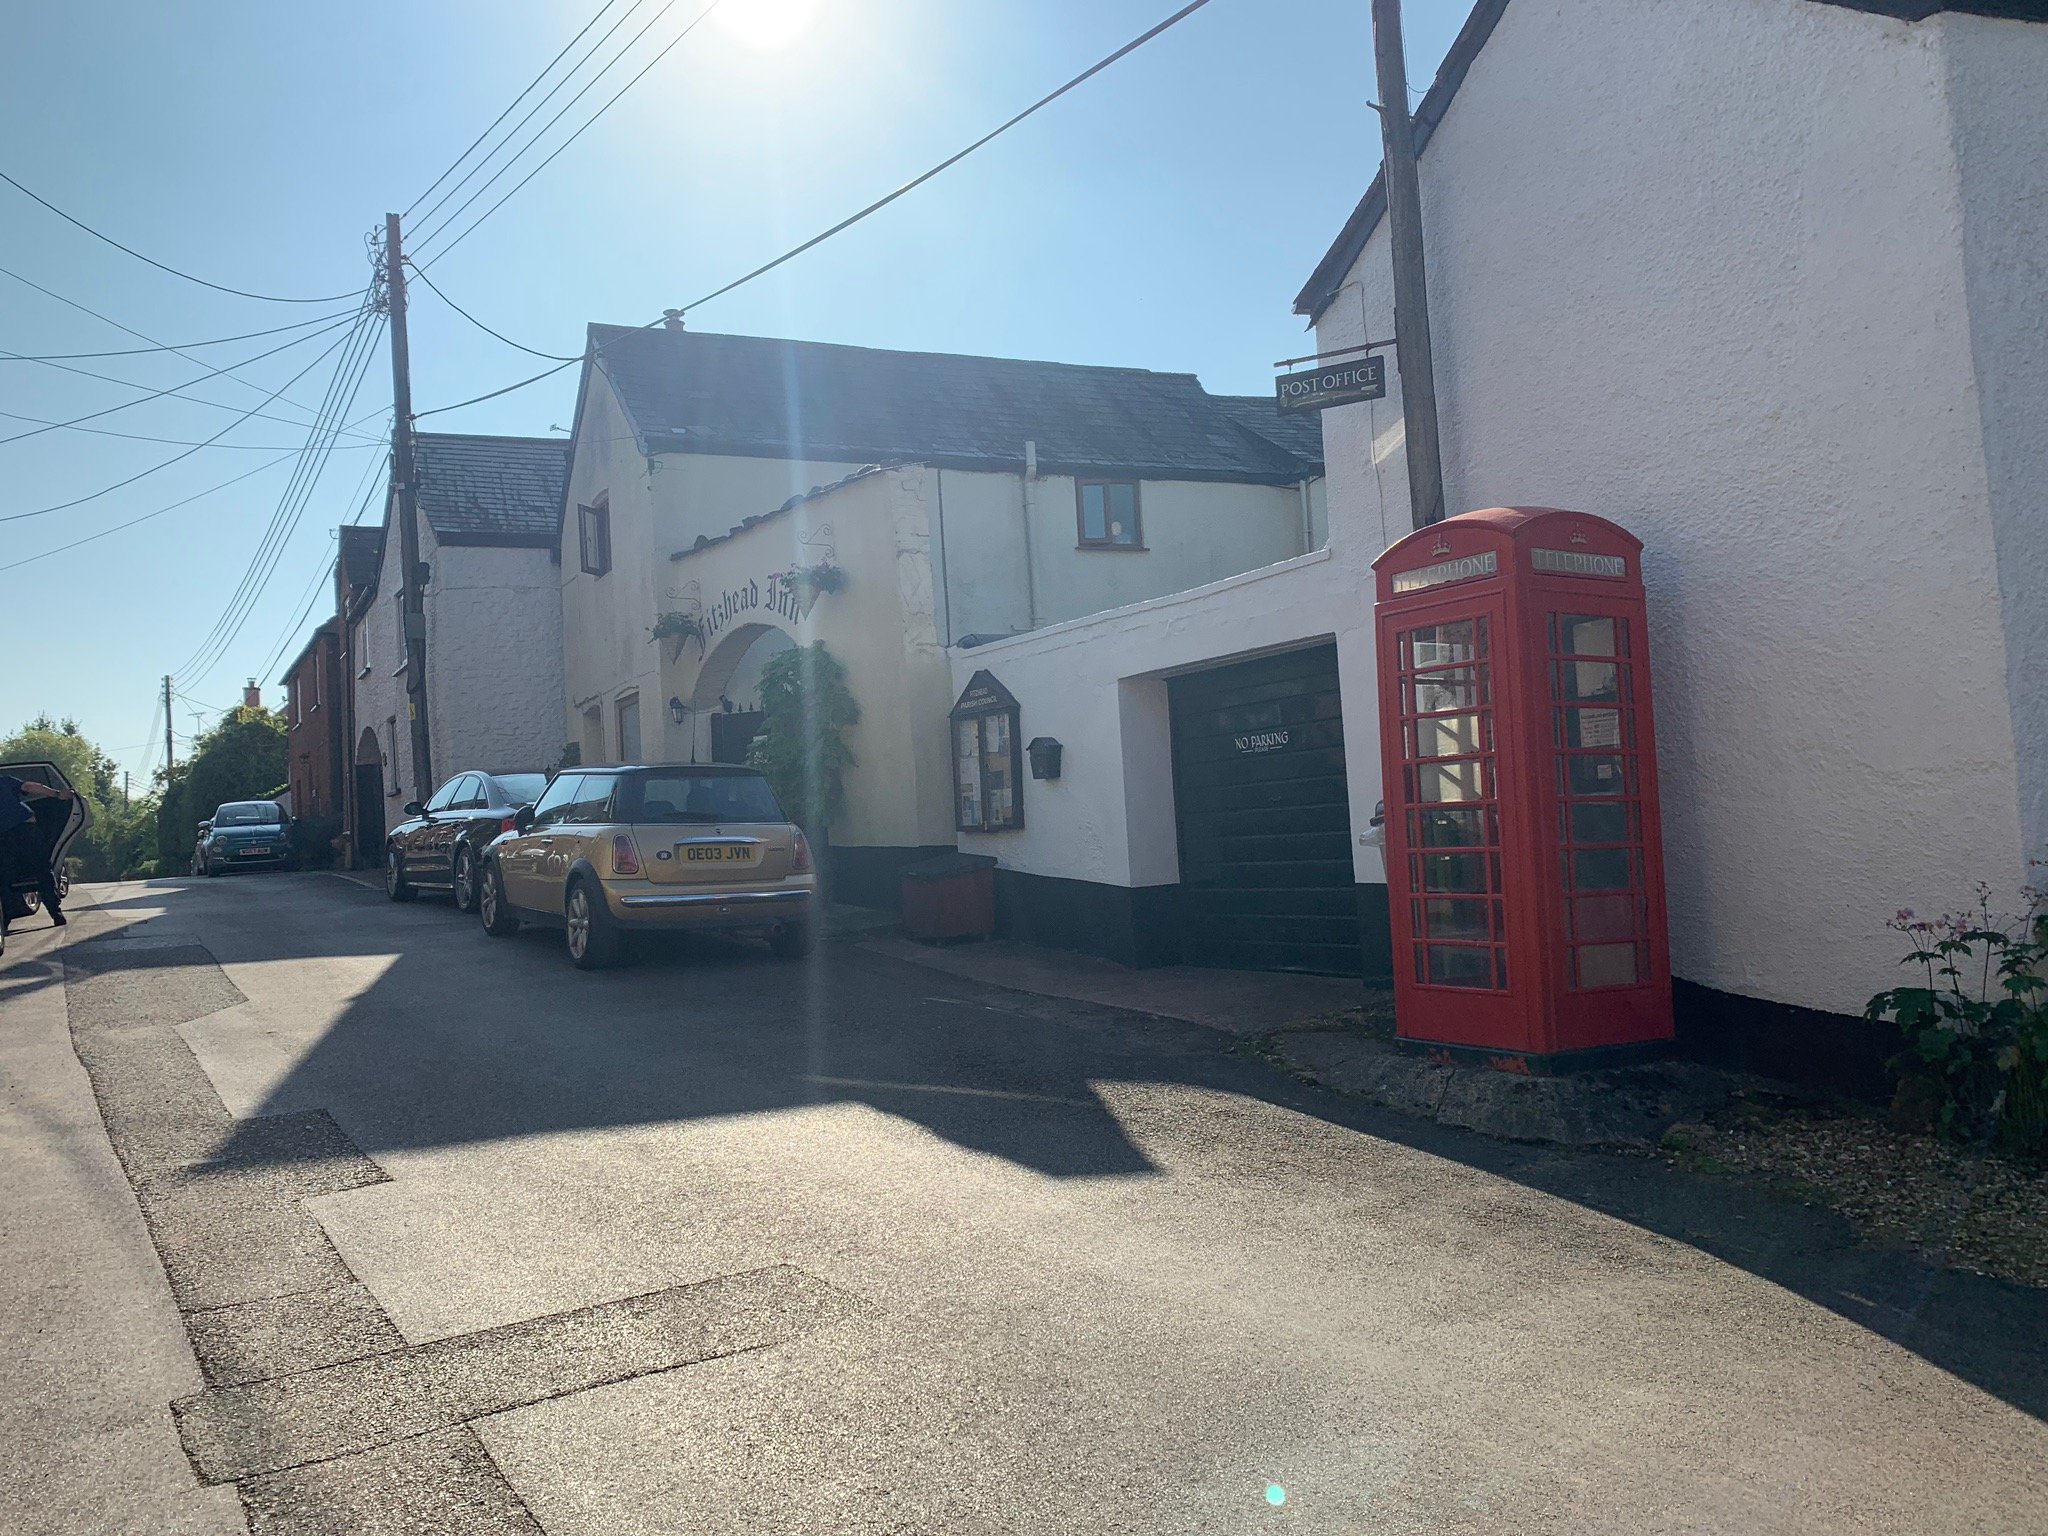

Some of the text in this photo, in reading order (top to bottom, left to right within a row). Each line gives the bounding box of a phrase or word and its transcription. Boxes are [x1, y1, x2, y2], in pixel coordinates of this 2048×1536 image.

[1280, 366, 1377, 398] POST OFFICE
[1395, 553, 1494, 591] TELEPHONE
[1533, 550, 1624, 577] TELEPHONE
[764, 572, 800, 625] Inn
[960, 695, 998, 709] PARISH COUNCIL
[1234, 731, 1289, 750] NO PARKING
[687, 847, 722, 861] OE03
